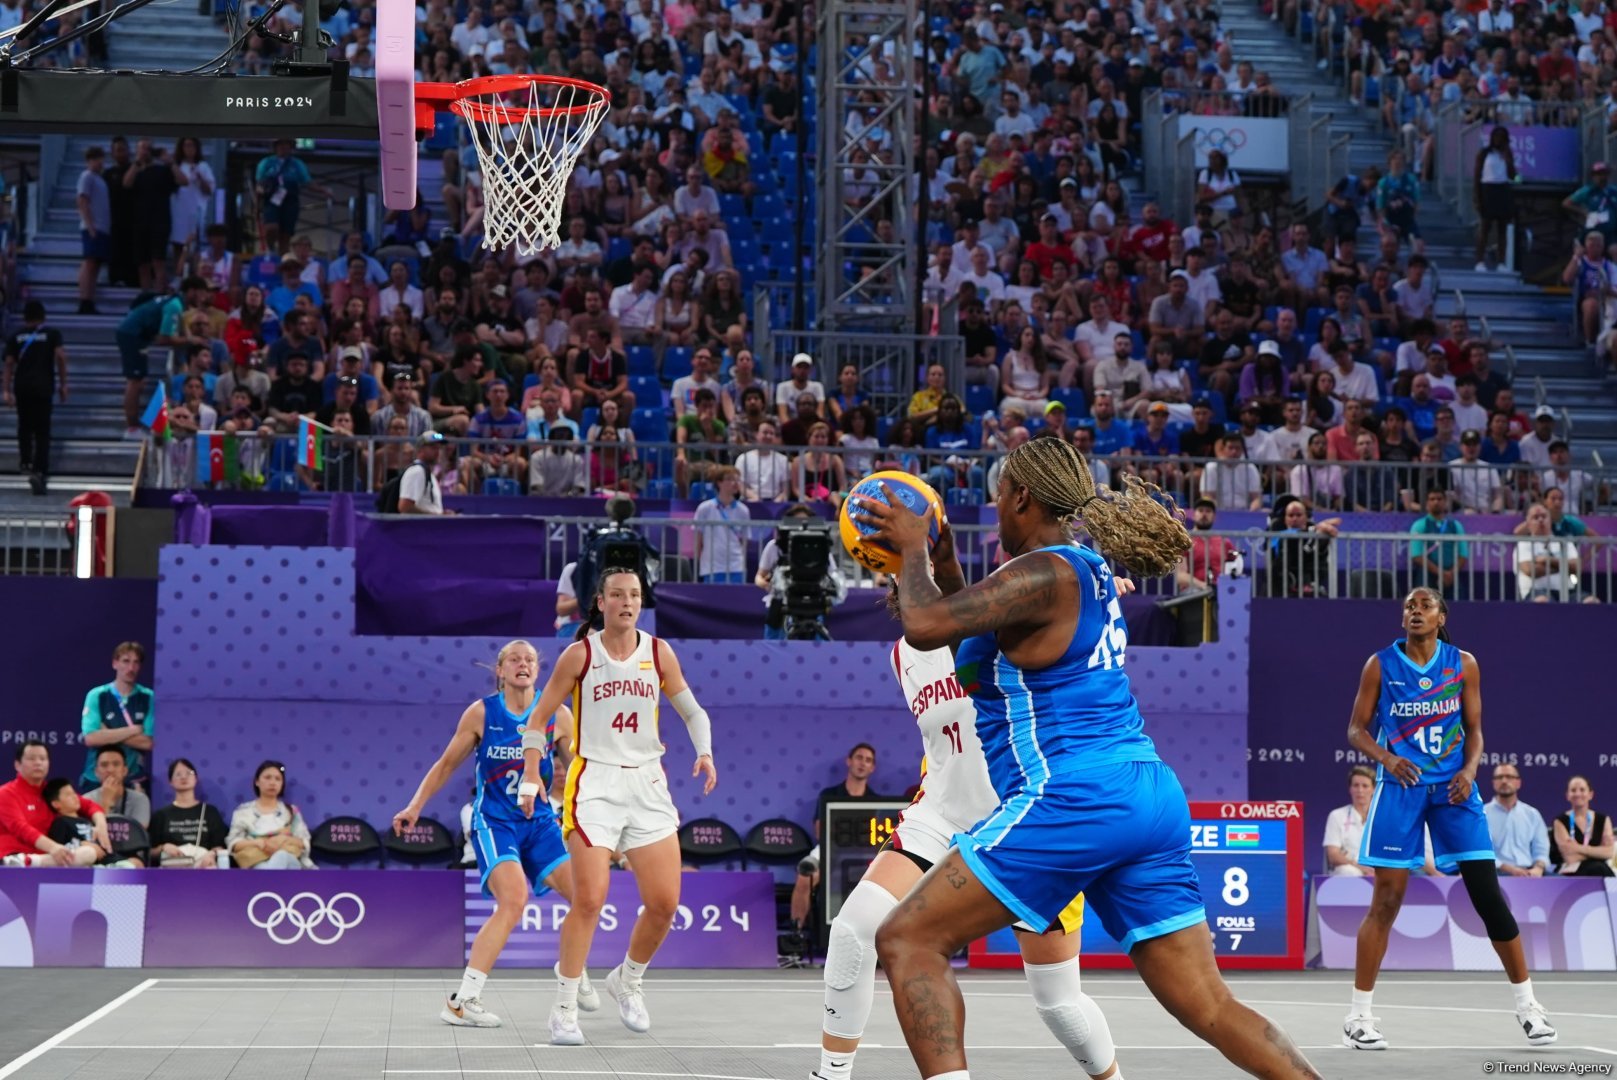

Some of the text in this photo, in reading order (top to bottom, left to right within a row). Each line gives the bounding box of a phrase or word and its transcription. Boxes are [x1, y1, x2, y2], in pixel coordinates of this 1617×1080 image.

[226, 97, 313, 108] PARIS 2024
[593, 678, 656, 702] ESPAÑA
[912, 672, 968, 719] ESPAÑ
[611, 711, 638, 733] 44
[942, 721, 963, 756] 11
[1413, 725, 1443, 755] 15
[1258, 748, 1306, 763] 2024
[1480, 752, 1570, 767] ARIS 2024
[505, 769, 524, 795] 2
[1238, 803, 1300, 818] OMEGA
[330, 824, 361, 833] PARIS
[692, 826, 722, 836] PARIS
[763, 826, 793, 836] PARIS
[1189, 825, 1219, 847] ZE
[330, 833, 362, 843] 2024
[404, 833, 434, 844] 2024
[693, 835, 723, 845] 2024
[764, 835, 793, 845] 2024
[1222, 866, 1249, 906] 8
[1216, 917, 1256, 928] FOULS
[1230, 934, 1243, 951] 7
